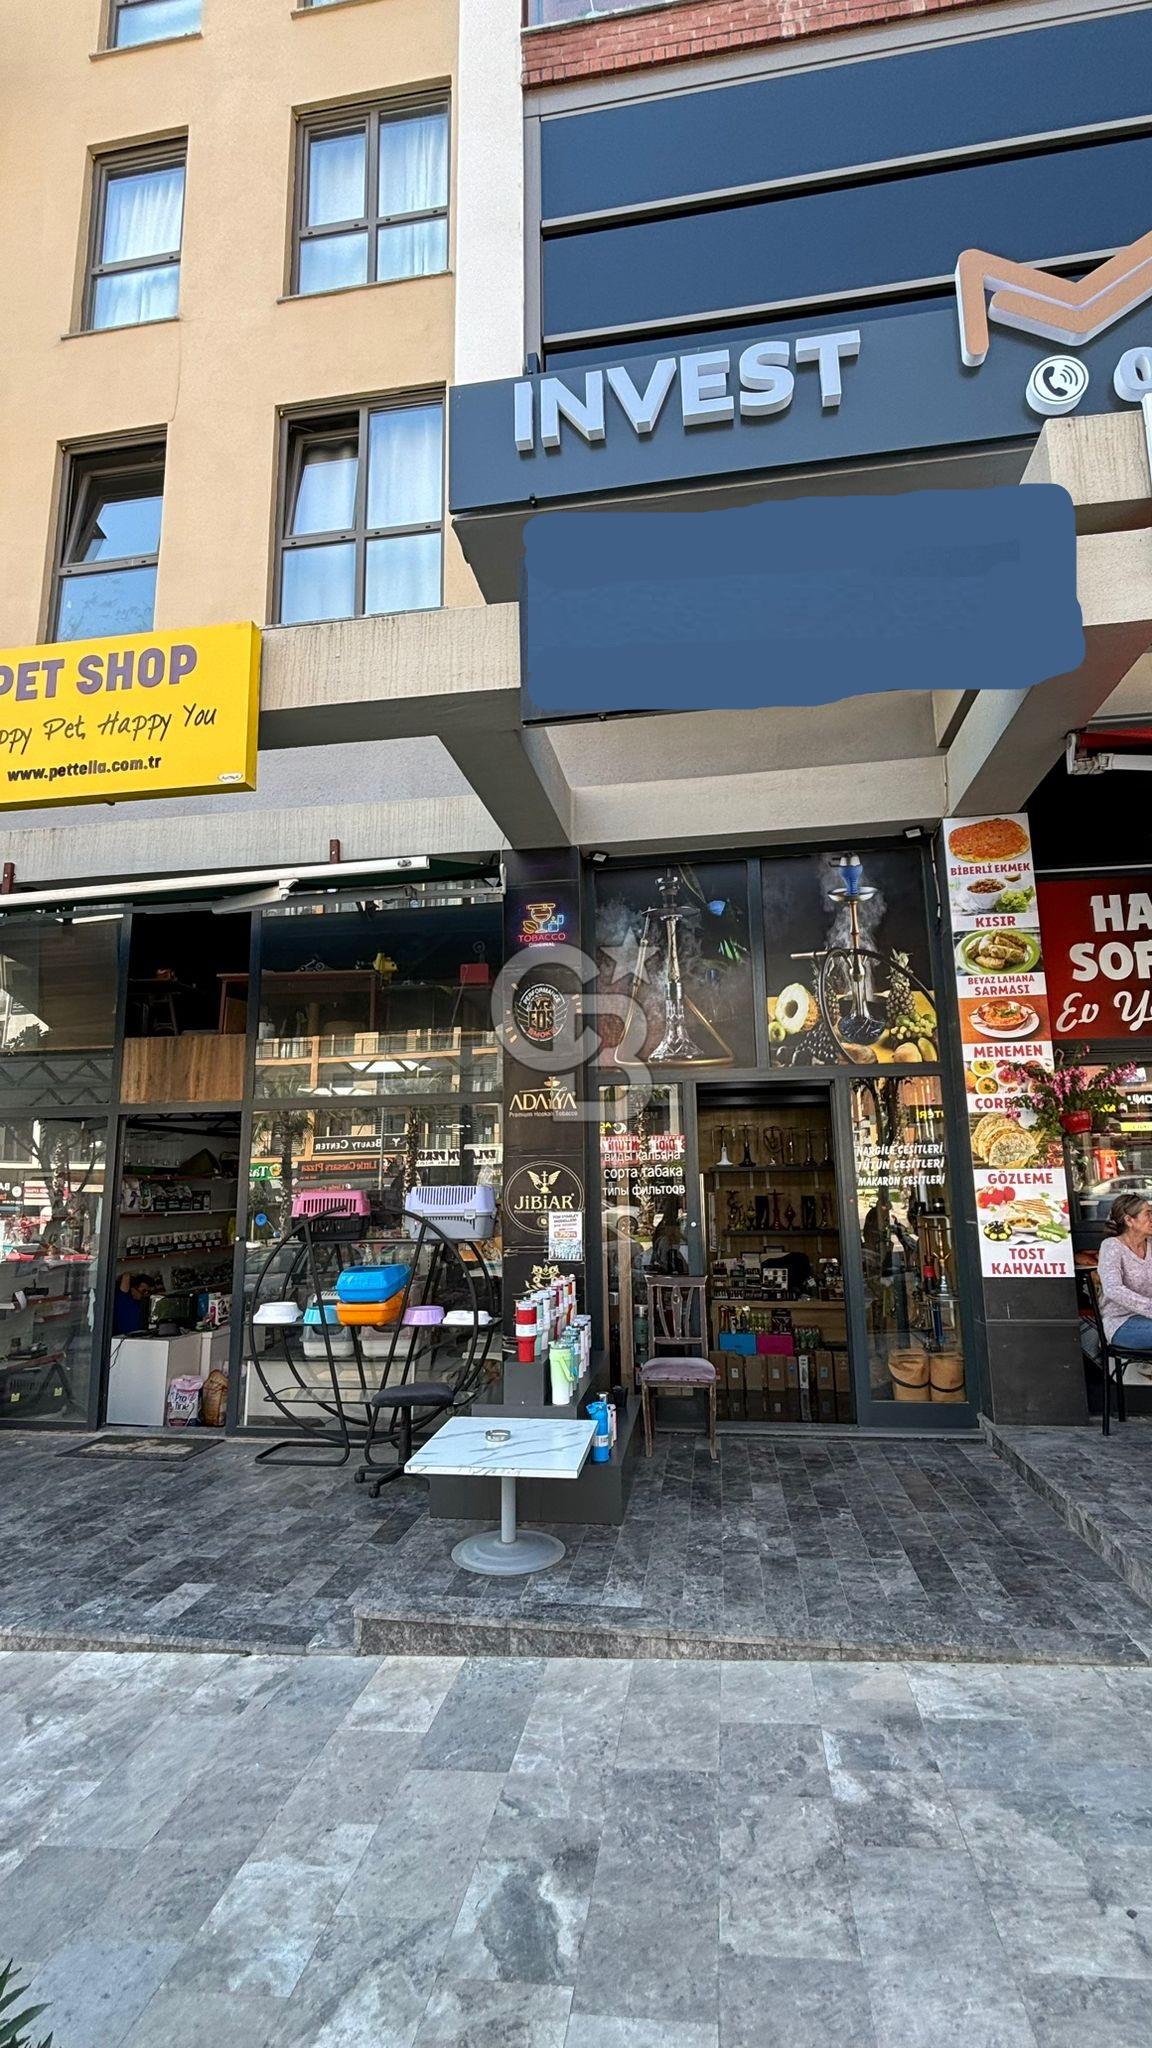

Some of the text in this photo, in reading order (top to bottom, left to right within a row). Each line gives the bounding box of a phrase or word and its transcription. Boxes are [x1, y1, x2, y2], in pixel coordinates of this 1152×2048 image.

[514, 329, 861, 452] INVEST
[0, 644, 197, 701] PET SHOP
[98, 711, 172, 741] Happy
[183, 703, 217, 727] You
[8, 756, 161, 781] www.pettella.com.tr
[950, 863, 1031, 876] BİBERLİ EKMEK
[975, 916, 1016, 928] KISIR
[518, 932, 566, 942] TOBACCO
[968, 974, 1035, 985] BEYAZ LAHANA
[974, 985, 1030, 996] SARMASI
[1056, 992, 1099, 1033] Ev
[974, 1045, 1043, 1058] MENEMEN
[604, 1150, 680, 1163] виды кальяна
[603, 1164, 683, 1181] сорта табака
[987, 1171, 1053, 1184] GÖZLEME
[858, 1176, 900, 1186] MAKARON
[602, 1187, 629, 1196] типы
[1008, 1248, 1045, 1260] TOST
[991, 1262, 1066, 1275] KAHVALTI
